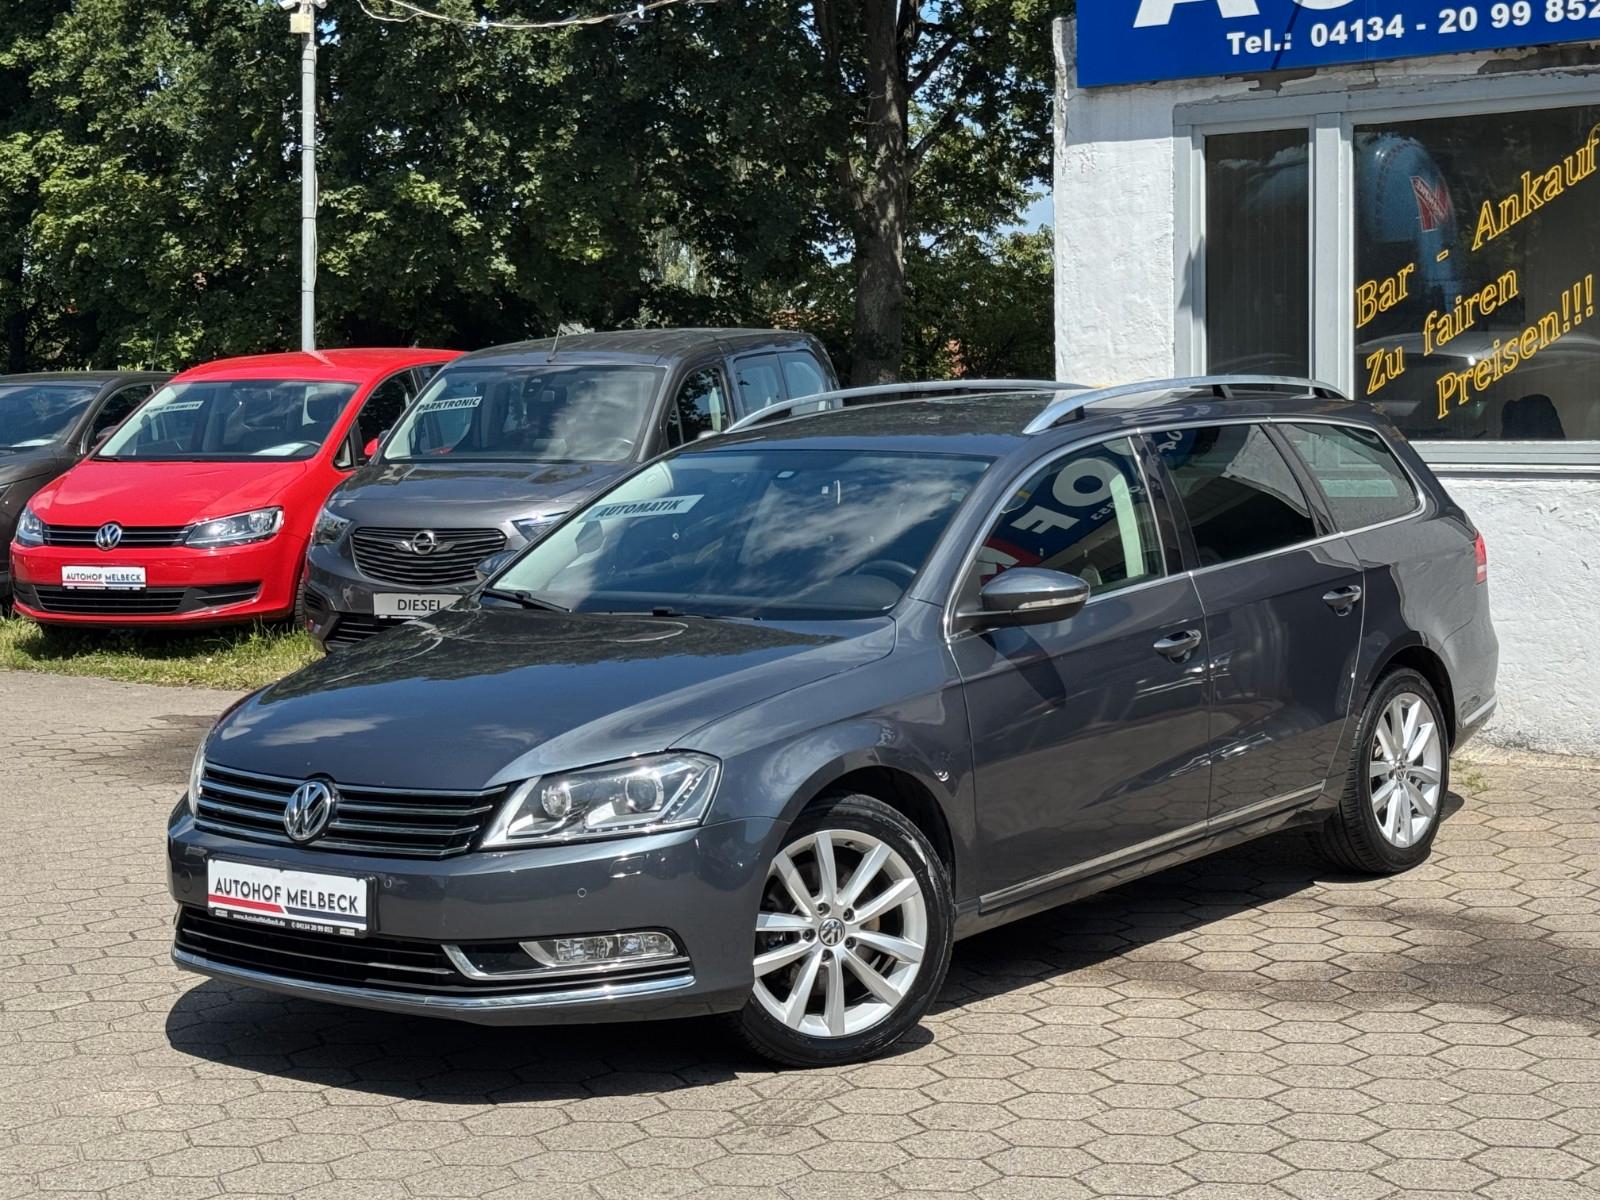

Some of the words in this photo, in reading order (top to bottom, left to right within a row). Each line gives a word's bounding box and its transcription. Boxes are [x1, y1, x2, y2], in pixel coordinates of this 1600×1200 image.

[1226, 28, 1292, 56] Tel.:
[1310, 13, 1405, 48] 04134
[1437, 6, 1479, 35] 20
[1490, 0, 1532, 29] 99
[1355, 262, 1415, 330] Bar
[1471, 122, 1600, 252] Ankauf
[1366, 345, 1406, 396] Zu
[1422, 269, 1520, 357] fairen
[1436, 273, 1595, 420] Preisen!!!
[416, 397, 481, 412] PARKTRONIC
[594, 499, 686, 519] AUTOMATIK
[66, 572, 103, 581] AUTOHOF
[104, 573, 142, 582] MELBECK
[397, 598, 441, 612] DIESEL
[214, 877, 282, 901] AUTOHOF
[286, 887, 359, 914] MELBECK
